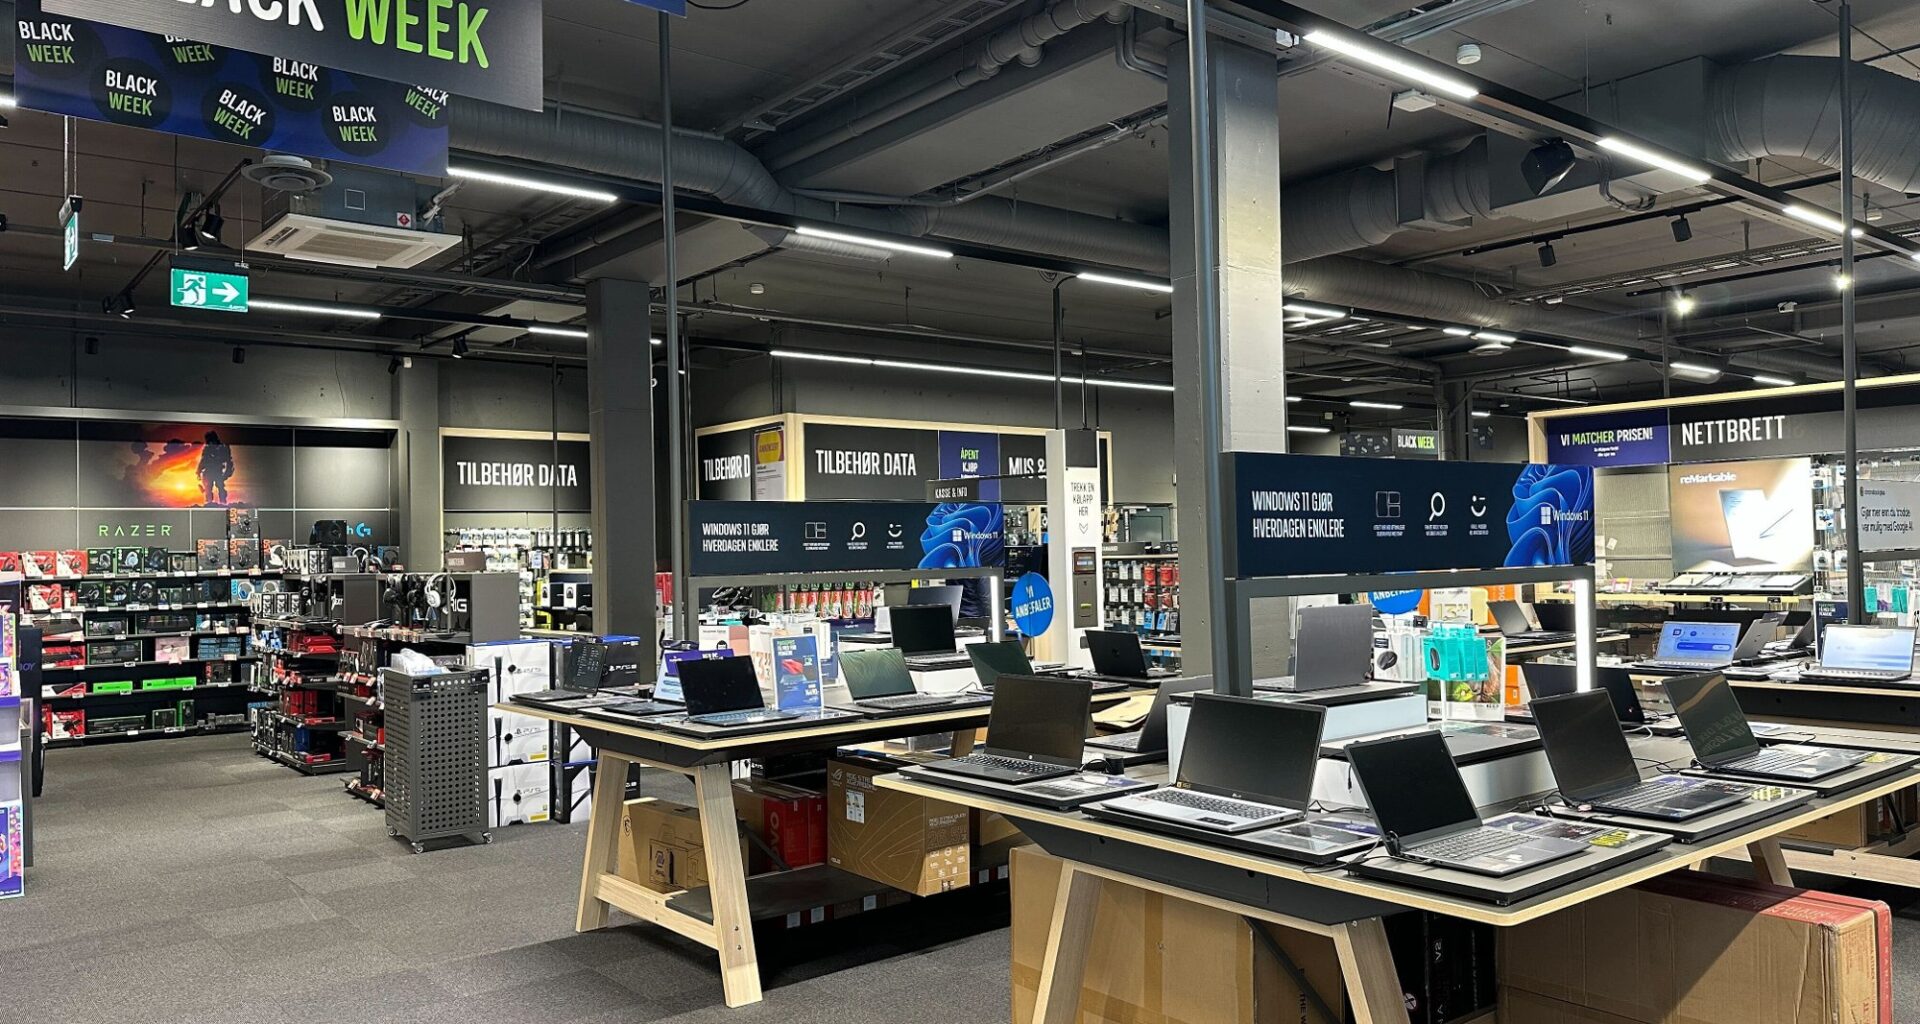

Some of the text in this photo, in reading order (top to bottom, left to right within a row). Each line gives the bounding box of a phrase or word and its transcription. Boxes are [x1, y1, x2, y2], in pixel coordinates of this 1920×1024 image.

[18, 20, 75, 42] BLACK
[345, 0, 490, 69] WEEK
[26, 44, 75, 64] WEEK
[172, 44, 215, 64] WEEK
[273, 57, 318, 82] BLACK
[105, 69, 157, 97] BLACK
[276, 77, 314, 101] WEEK
[108, 91, 153, 116] WEEK
[219, 89, 267, 125] BLACK
[405, 88, 440, 121] WEEK
[212, 107, 256, 140] WEEK
[332, 105, 377, 123] BLACK
[338, 125, 377, 143] WEEK
[1560, 427, 1653, 447] VI MATCHER PRISEN!
[1682, 415, 1786, 446] NETTBRETT
[1397, 435, 1417, 449] BLACK
[1417, 436, 1435, 449] WEEK
[815, 449, 917, 476] TILBEHØR DATA
[960, 447, 979, 460] ÅPENT
[457, 461, 578, 488] TILBEHØR DATA
[703, 455, 743, 482] TILBEHØR
[1680, 472, 1737, 484] reMarkable
[935, 487, 968, 499] KASSE & INFO
[1071, 482, 1087, 493] TREKK
[1079, 506, 1089, 517] HER
[1252, 491, 1333, 512] WINDOWS 11 GJØR
[1552, 509, 1589, 522] Windows 11
[99, 525, 171, 537] RAZER
[702, 523, 769, 536] WINDOWS 11 GJØR
[964, 531, 992, 539] Windows
[1253, 517, 1345, 539] HVERDAGEN ENKLERE
[703, 539, 779, 552] HVERDAGEN ENKLERE
[1015, 597, 1052, 618] ANBEFALER
